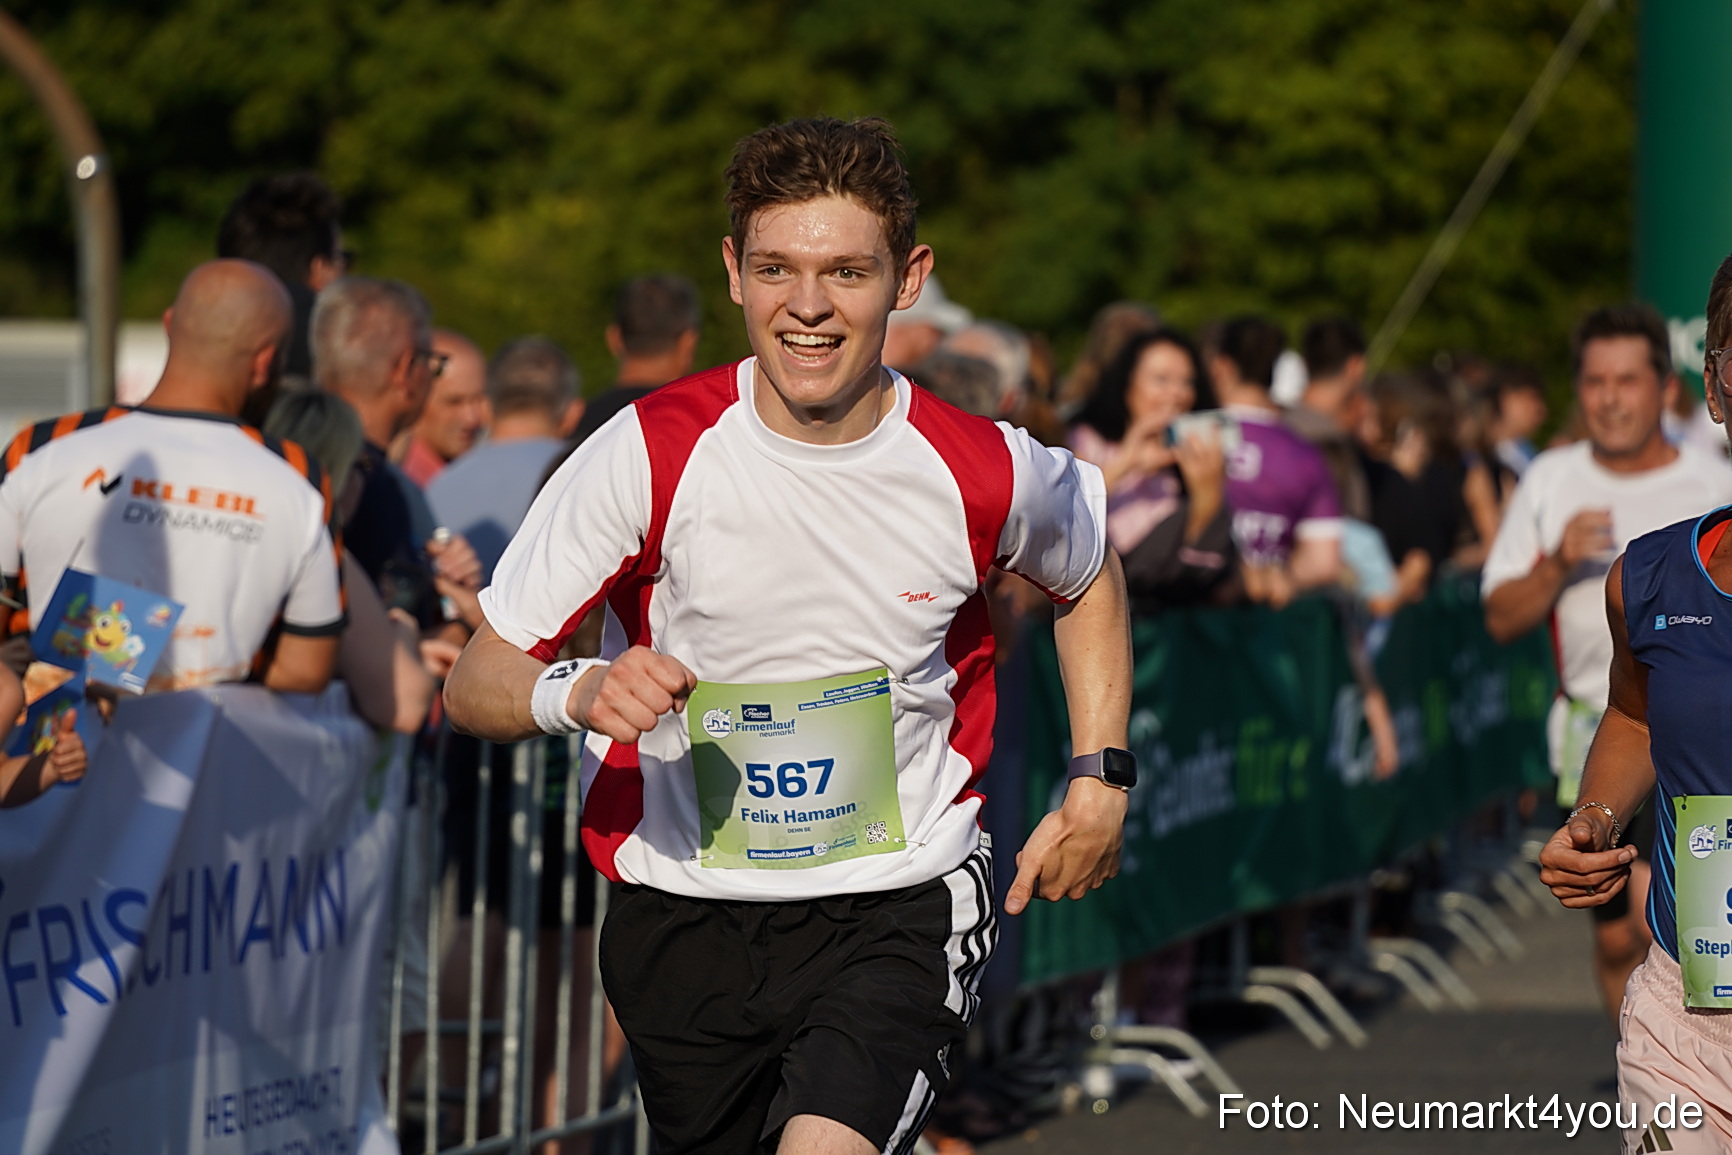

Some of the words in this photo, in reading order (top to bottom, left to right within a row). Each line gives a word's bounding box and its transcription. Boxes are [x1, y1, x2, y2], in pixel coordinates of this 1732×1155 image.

[908, 591, 930, 602] DEHN
[735, 718, 796, 732] Firmenlauf
[759, 729, 796, 738] neumarkt
[745, 757, 835, 799] 567
[741, 808, 780, 824] Felix
[783, 802, 857, 824] Hamann
[750, 849, 811, 859] firmenlauf.bayern
[1695, 938, 1732, 958] Step
[1716, 988, 1732, 996] firm
